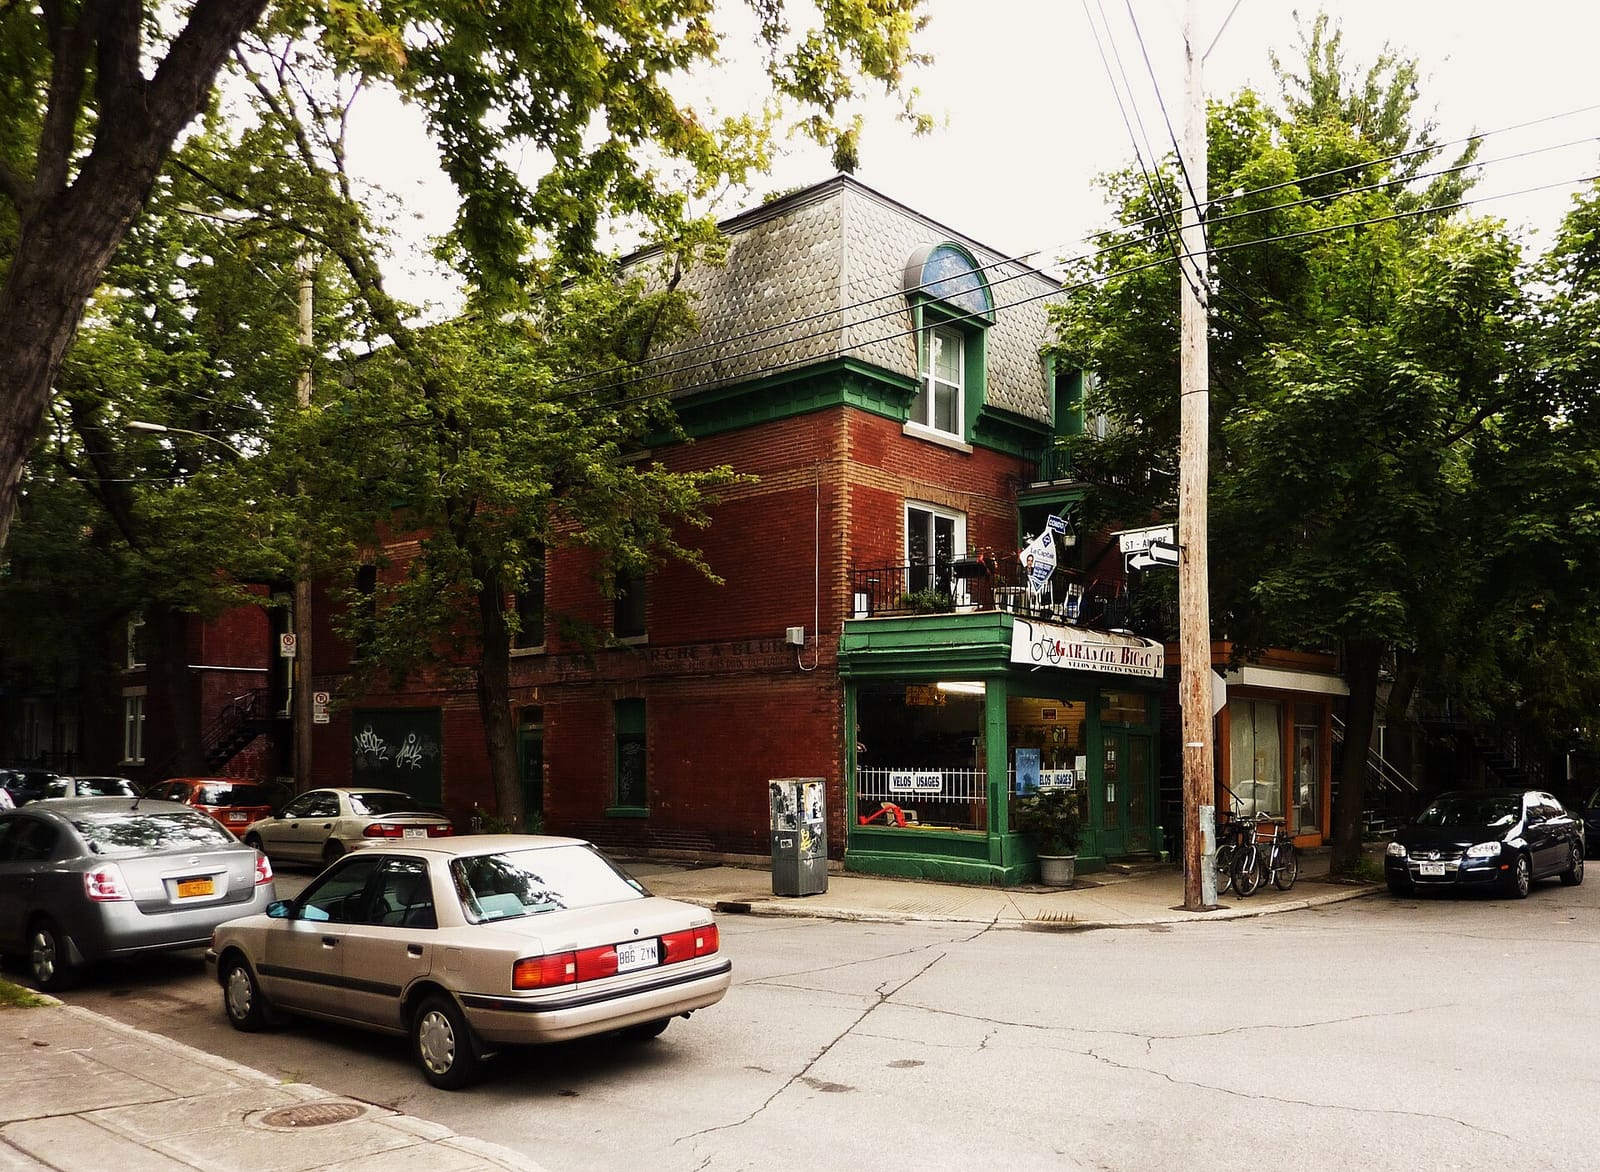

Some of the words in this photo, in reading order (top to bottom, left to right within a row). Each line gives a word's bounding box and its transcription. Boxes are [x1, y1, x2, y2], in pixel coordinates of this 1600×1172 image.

[1120, 647, 1163, 669] BICYCE
[893, 776, 911, 787] VELOS
[916, 776, 940, 787] USAGES
[1040, 774, 1051, 785] ELOS
[641, 946, 657, 961] ZYN
